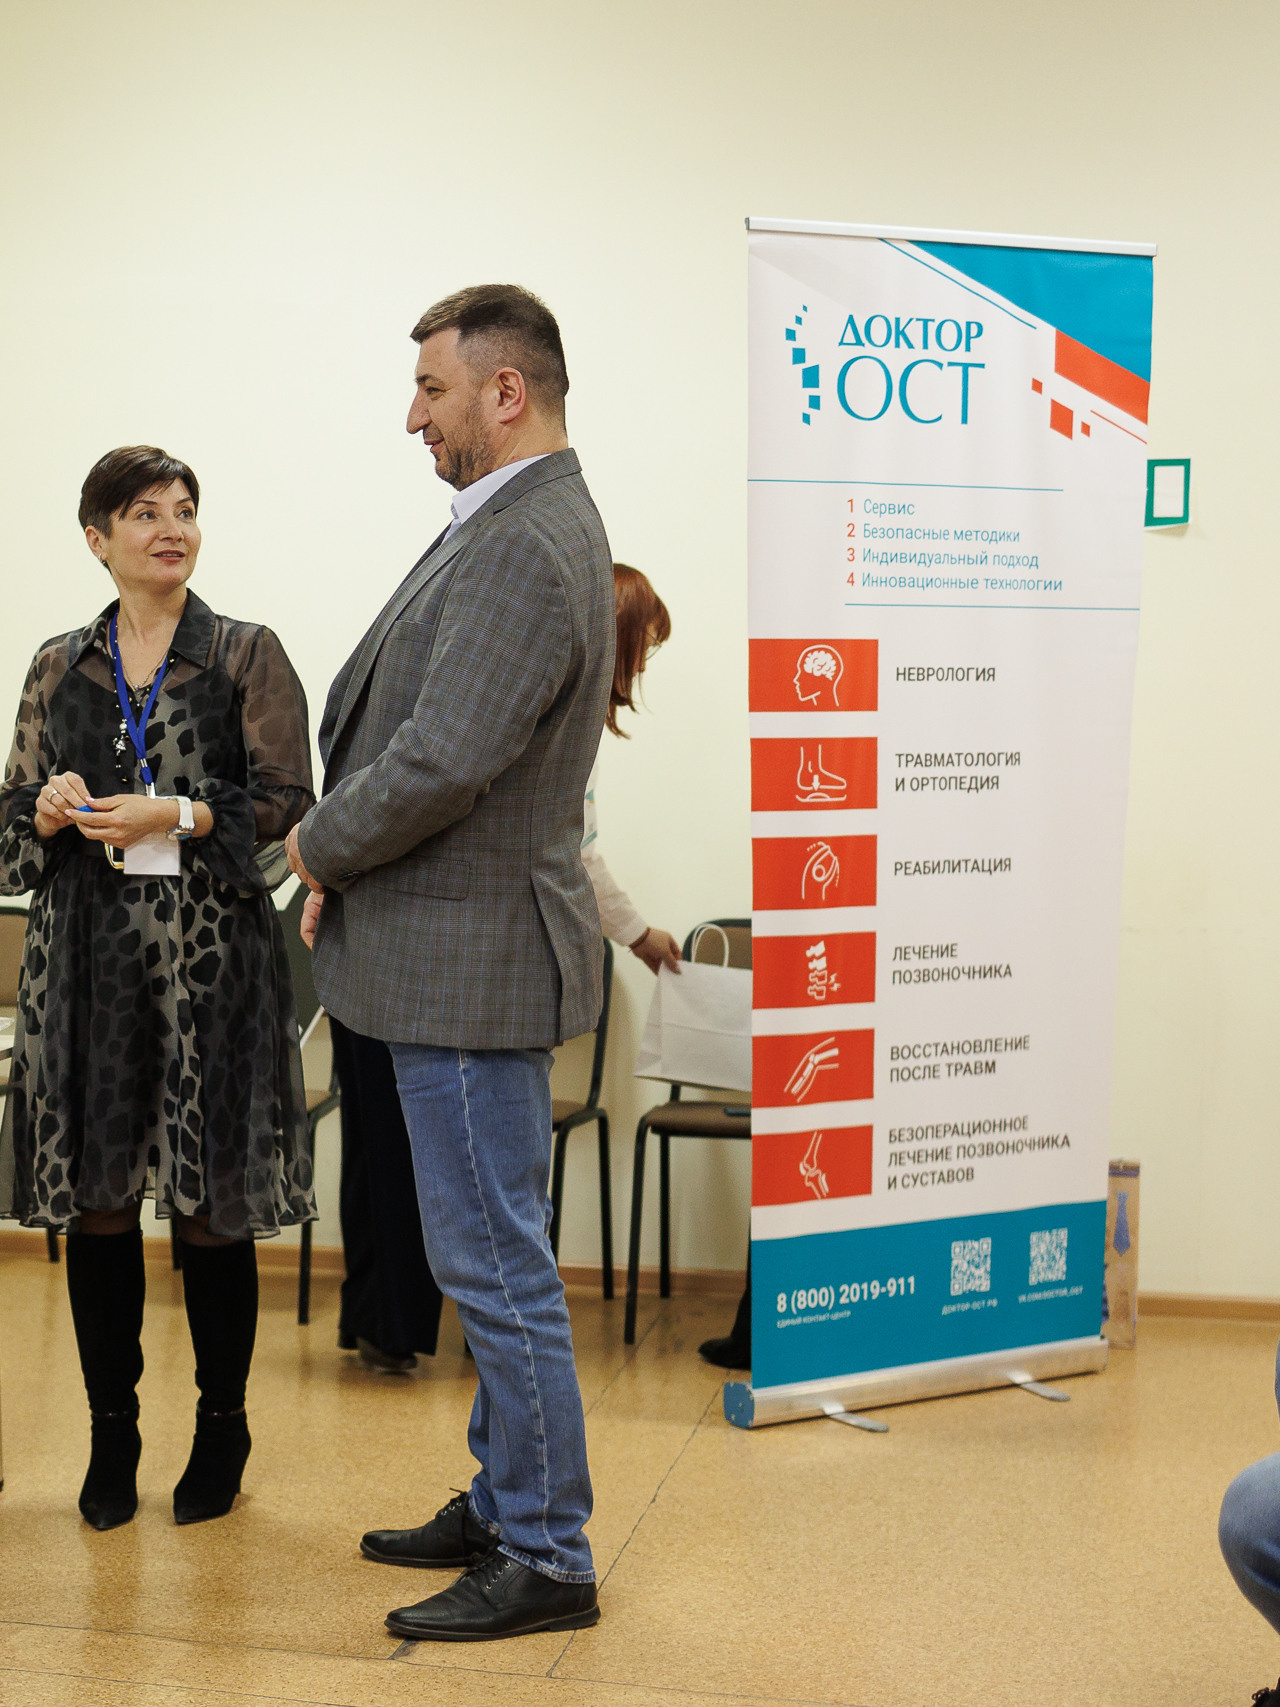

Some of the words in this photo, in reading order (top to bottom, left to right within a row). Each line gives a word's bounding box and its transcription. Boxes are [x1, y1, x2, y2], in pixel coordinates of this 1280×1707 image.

[838, 314, 984, 352] ДОКТОР
[836, 355, 986, 425] ОСТ
[846, 498, 855, 513] 1
[863, 499, 915, 518] Сервис
[846, 523, 856, 538] 2
[863, 523, 950, 542] Безопасные
[953, 529, 1021, 543] методики
[846, 547, 856, 562] 3
[862, 548, 989, 569] Индивидуальный
[992, 554, 1040, 570] подход
[846, 572, 856, 587] 4
[861, 573, 980, 592] Инновационные
[983, 578, 1063, 592] технологии
[895, 666, 996, 682] НЕВРОЛОГИЯ
[895, 751, 1021, 768] ТРАВМАТОЛОГИЯ
[895, 777, 906, 792] И
[909, 775, 1000, 794] ОРТОПЕДИЯ
[894, 857, 1012, 877] РЕАБИЛИТАЦИЯ
[892, 942, 959, 962] ЛЕЧЕНИЕ
[892, 963, 1013, 986] ПОЗВОНОЧНИКА
[890, 1034, 1031, 1062] ВОССТАНОВЛЕНИЕ
[889, 1063, 941, 1083] ПОСЛЕ
[945, 1059, 997, 1079] ТРАВМ
[888, 1114, 1030, 1145] БЕЗОПЕРАЦИОННОЕ
[887, 1145, 954, 1168] ЛЕЧЕНИЕ
[955, 1133, 1071, 1161] ПОЗВОНОЧНИКА
[887, 1175, 897, 1191] И
[901, 1166, 975, 1190] СУСТАВОВ
[776, 1292, 787, 1314] 8
[790, 1285, 836, 1315] (800)
[838, 1275, 916, 1306] 2019-911
